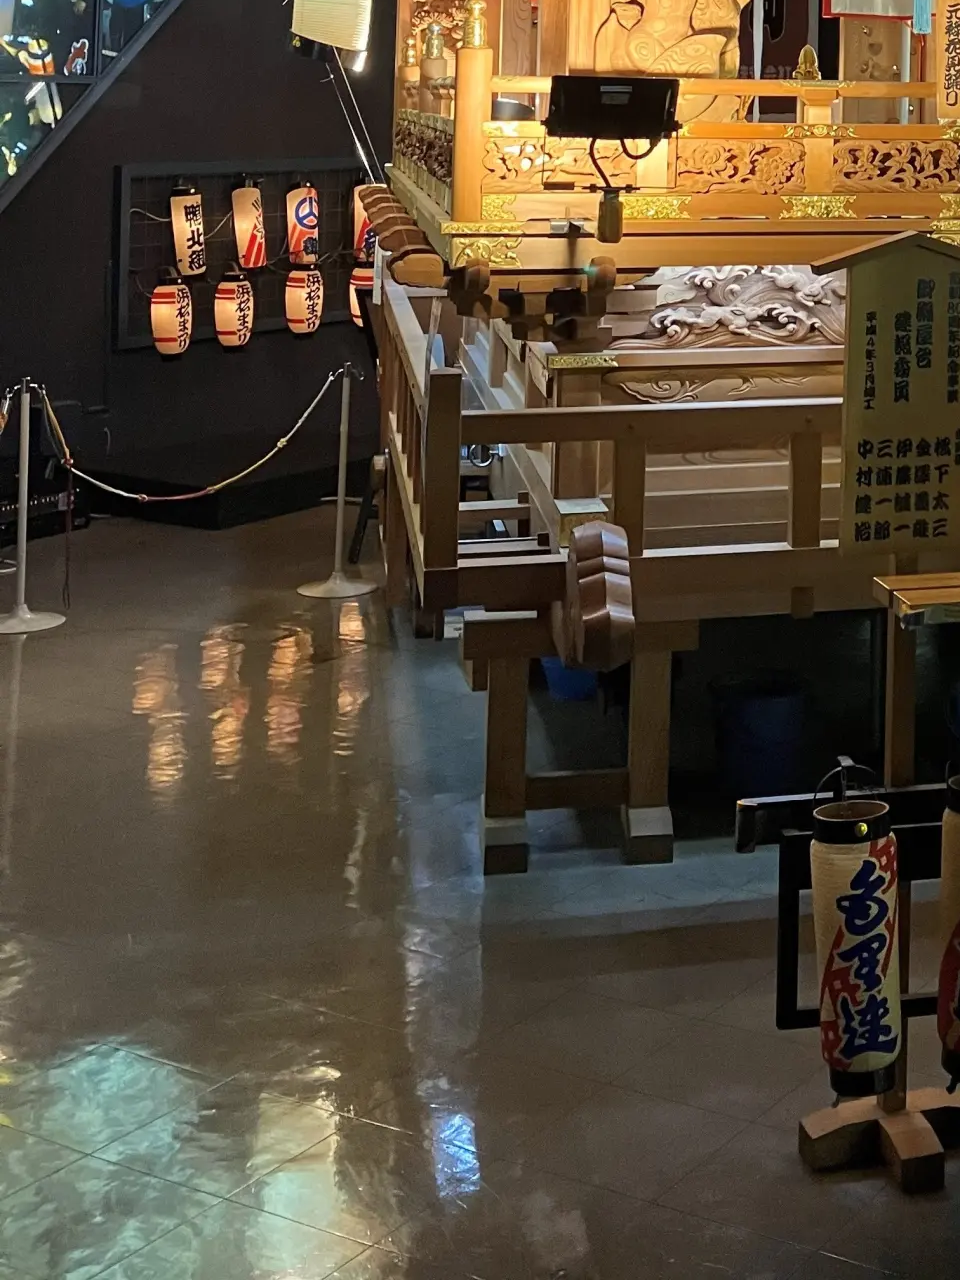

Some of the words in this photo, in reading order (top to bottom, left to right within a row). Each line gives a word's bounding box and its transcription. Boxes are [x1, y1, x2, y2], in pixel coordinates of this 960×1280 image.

[176, 287, 191, 351] 浜松まつり
[235, 282, 253, 346] 浜松まつり
[304, 273, 323, 330] 浜松まつり
[915, 278, 936, 369] 御殿屋台
